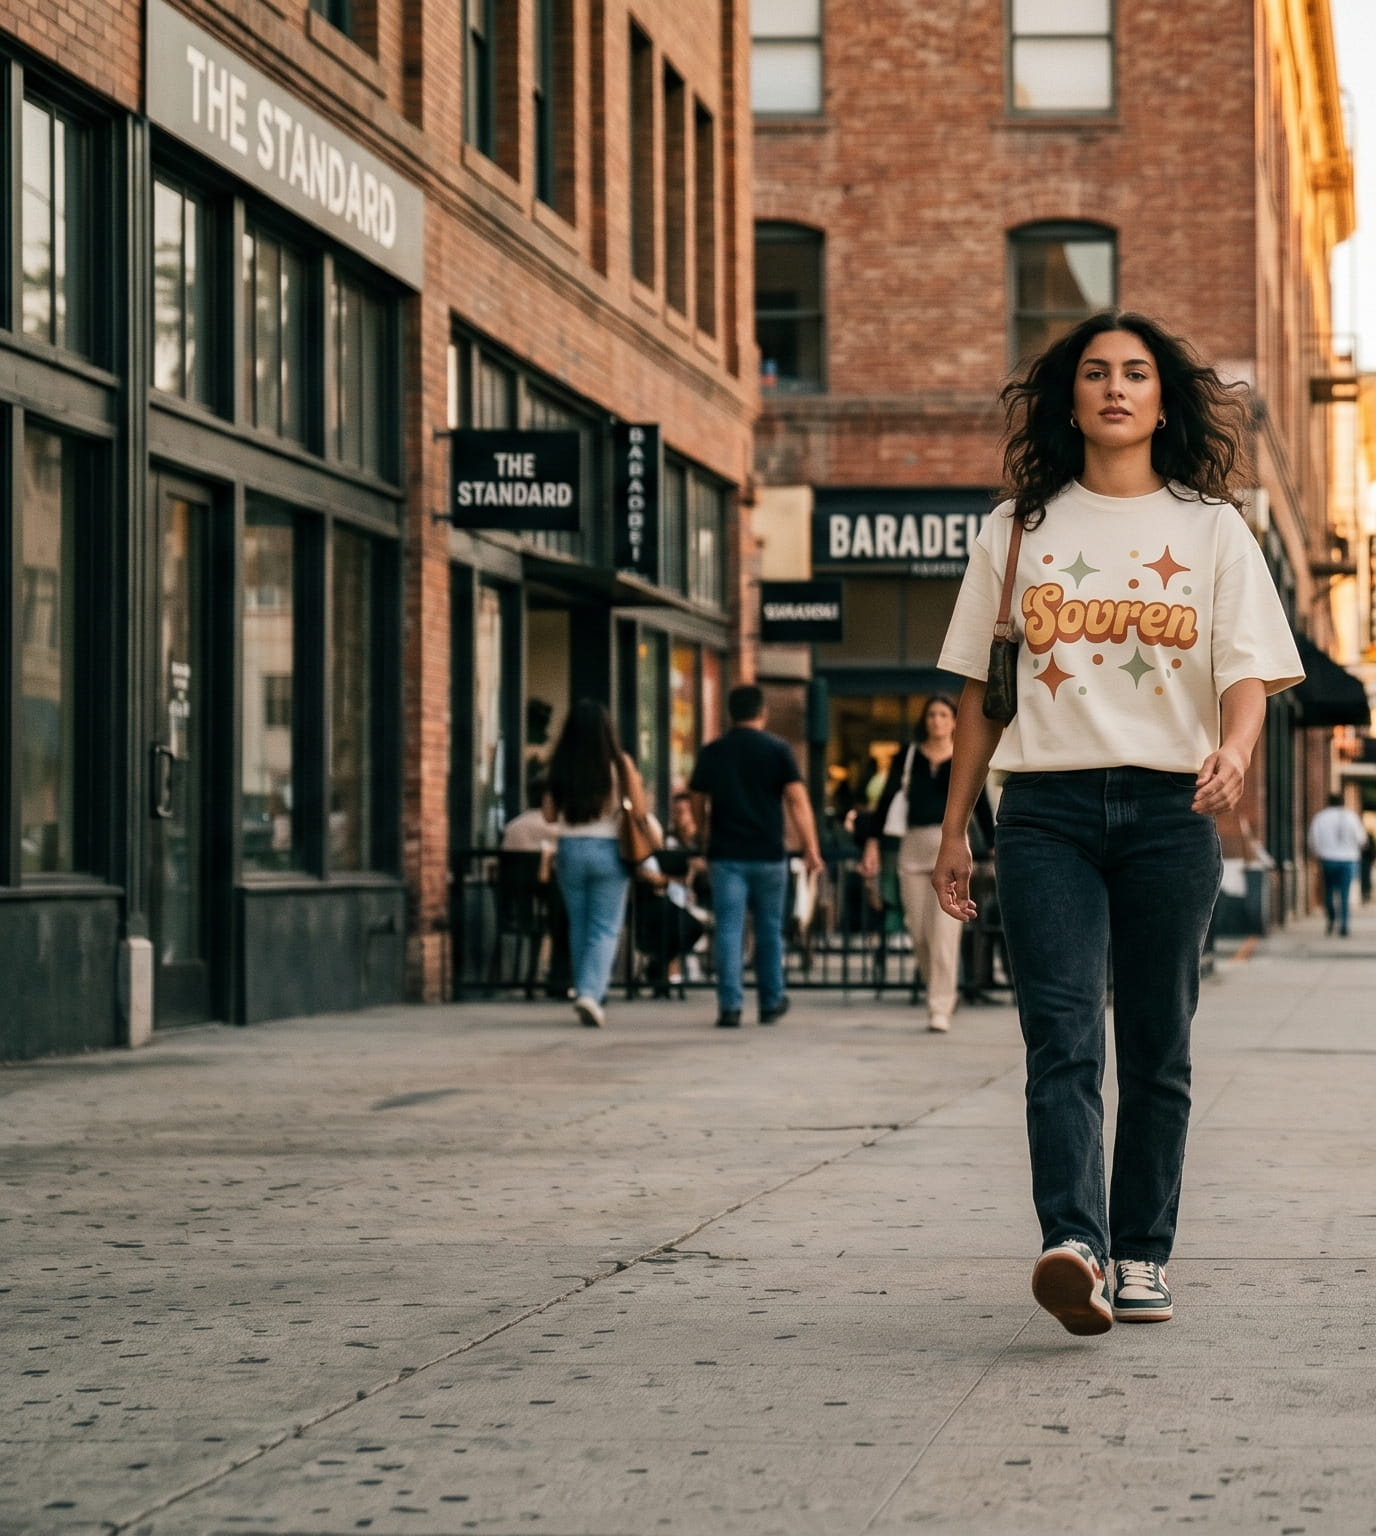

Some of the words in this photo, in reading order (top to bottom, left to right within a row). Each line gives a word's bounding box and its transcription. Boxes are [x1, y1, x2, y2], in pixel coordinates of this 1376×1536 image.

[186, 45, 249, 156] THE
[256, 98, 397, 250] STANDARD
[493, 452, 536, 479] THE
[457, 481, 573, 508] STANDARD
[1021, 582, 1199, 655] Sovren
